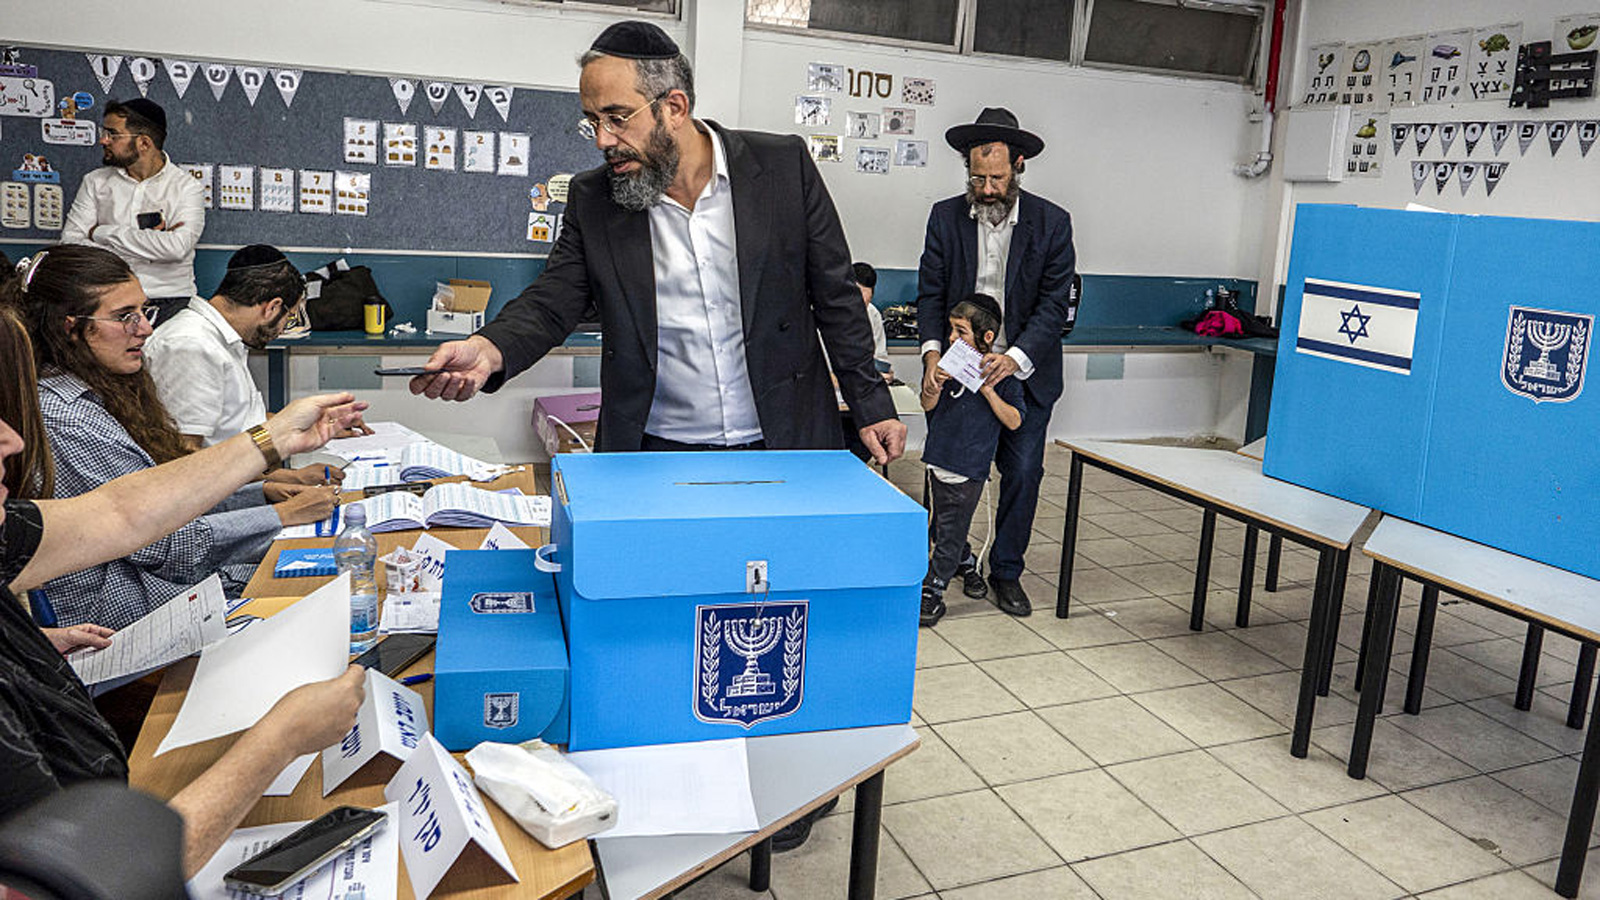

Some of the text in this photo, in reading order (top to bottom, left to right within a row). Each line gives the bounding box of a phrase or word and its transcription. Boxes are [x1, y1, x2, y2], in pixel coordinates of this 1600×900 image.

[847, 68, 893, 98] סתו
[1519, 374, 1563, 395] ישראל
[719, 698, 781, 717] ישראל
